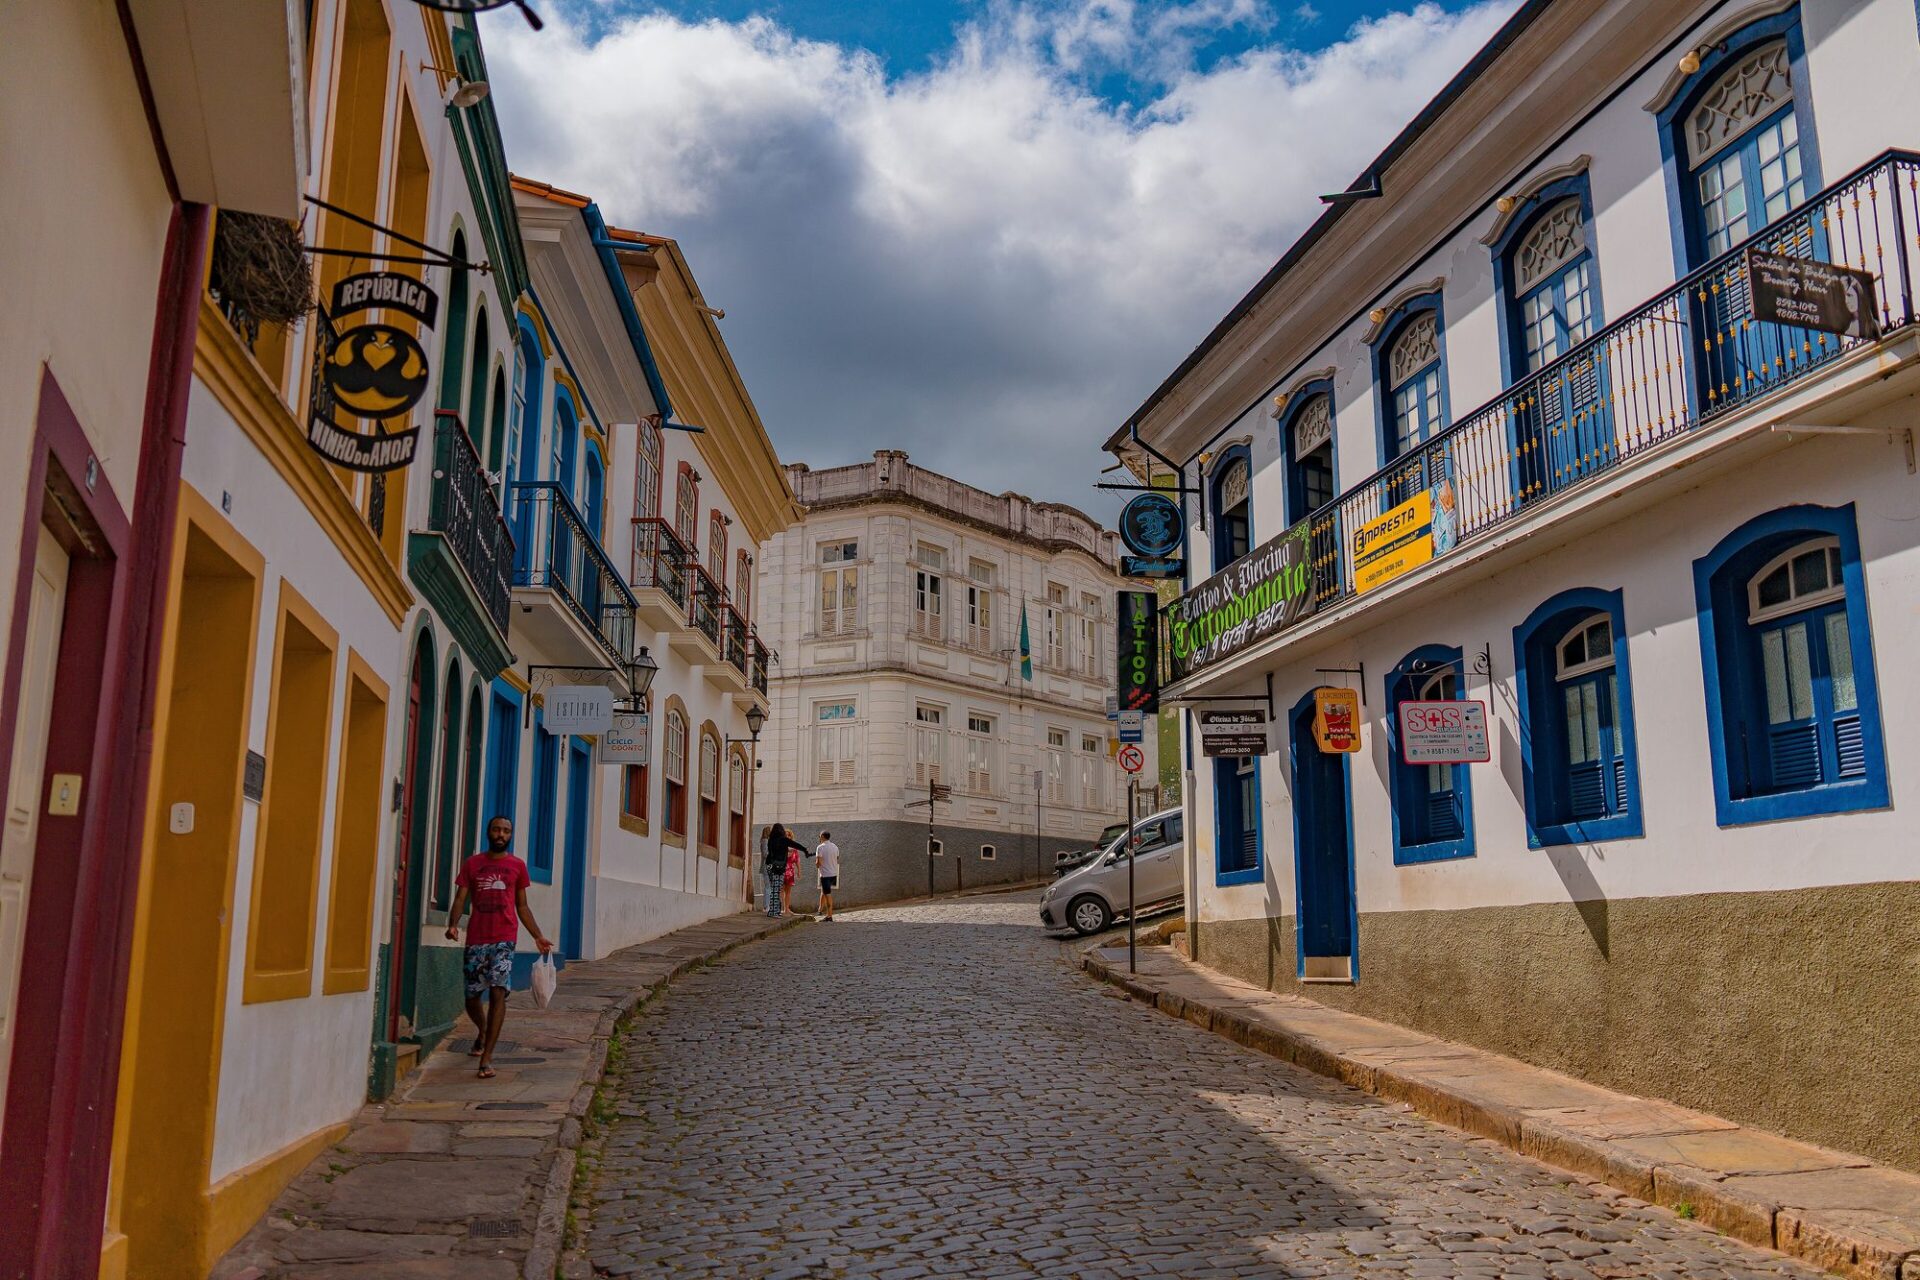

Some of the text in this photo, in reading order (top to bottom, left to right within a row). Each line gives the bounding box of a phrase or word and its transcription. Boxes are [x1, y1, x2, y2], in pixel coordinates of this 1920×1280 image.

[340, 273, 428, 314] REPÚBLICA
[310, 417, 414, 467] NINHO DO AMOR
[1182, 585, 1220, 622] Tattoo
[1223, 573, 1235, 602] &
[1131, 594, 1146, 685] TATTOO
[1407, 708, 1462, 732] SOS
